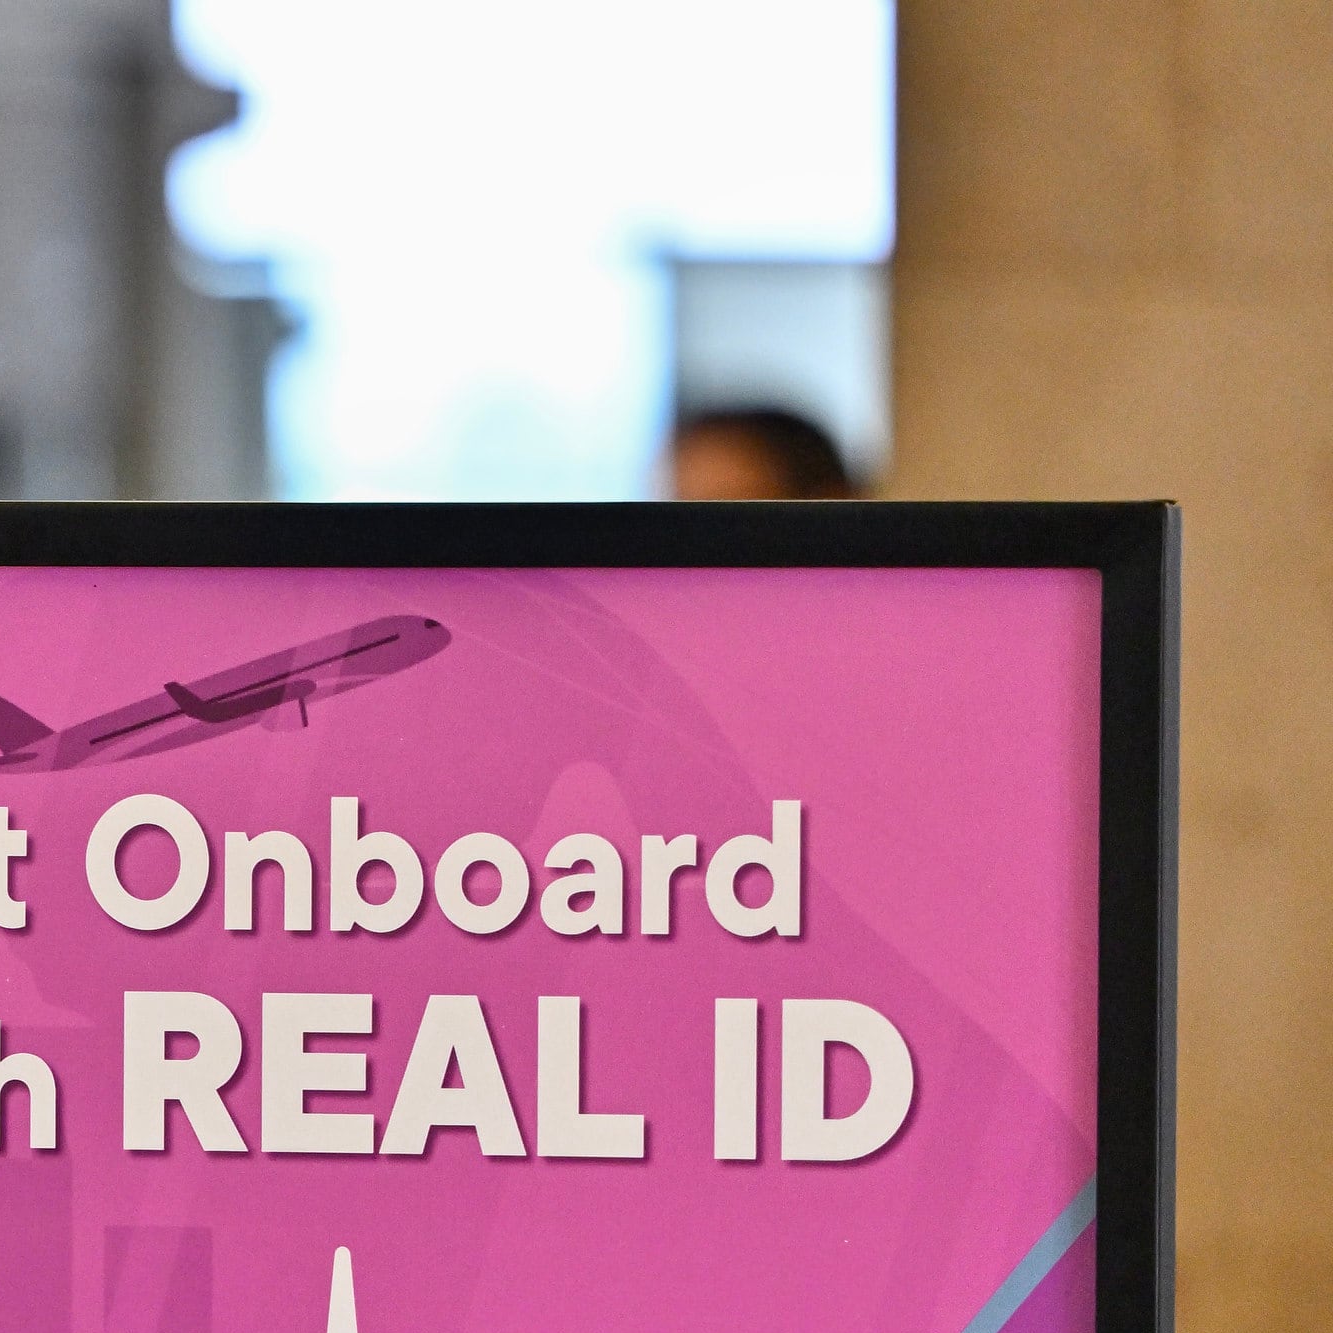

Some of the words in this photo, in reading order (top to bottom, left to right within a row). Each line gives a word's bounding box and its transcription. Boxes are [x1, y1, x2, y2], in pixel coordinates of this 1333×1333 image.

[85, 793, 802, 937] Onboard
[123, 990, 646, 1159] REAL
[715, 997, 916, 1162] ID
